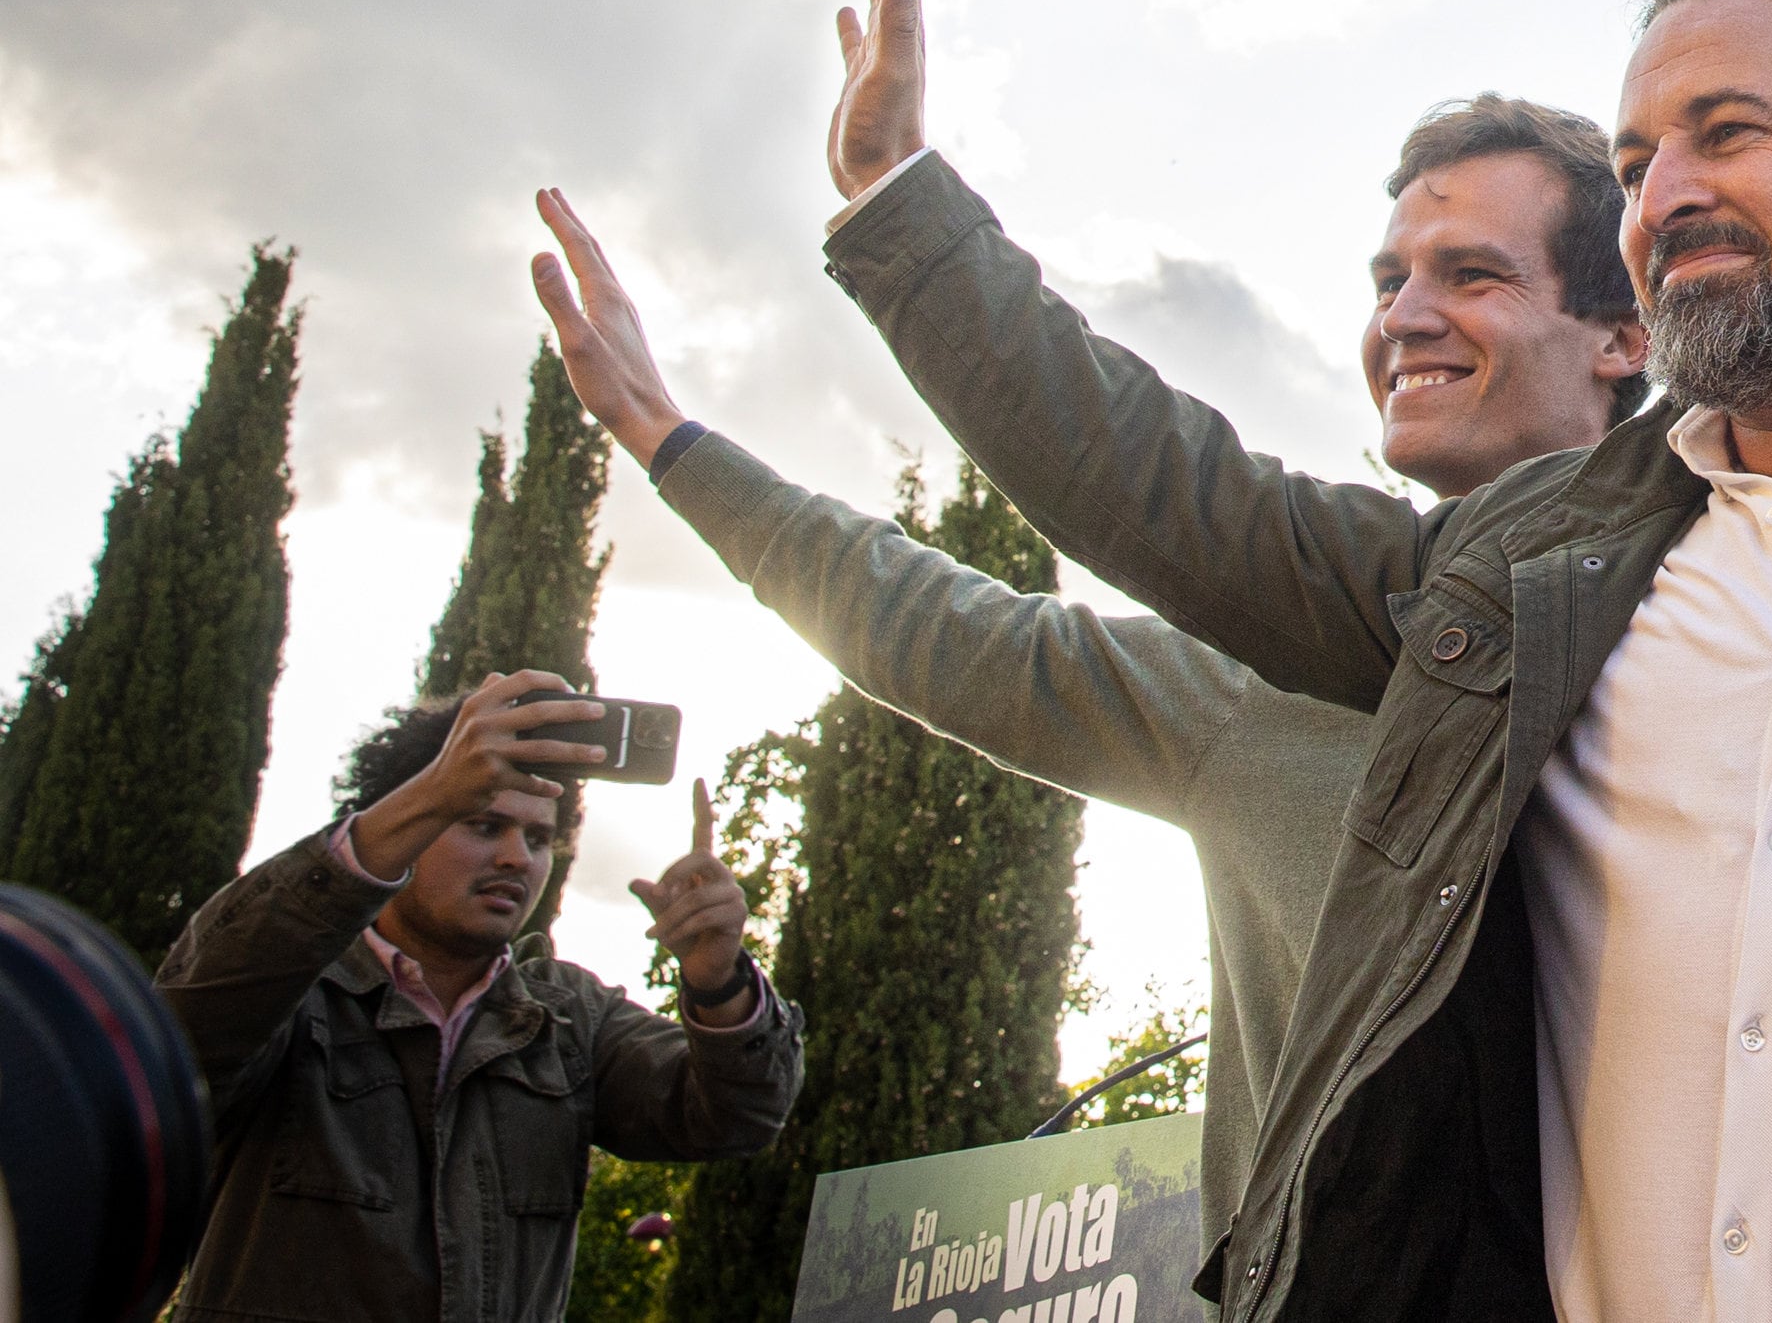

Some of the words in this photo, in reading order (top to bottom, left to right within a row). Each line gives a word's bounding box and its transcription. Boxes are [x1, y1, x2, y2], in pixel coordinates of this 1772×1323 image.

[892, 1257, 925, 1312] La
[926, 1230, 1003, 1301] Rioja
[1004, 1183, 1119, 1292] Vota
[910, 1207, 939, 1252] En
